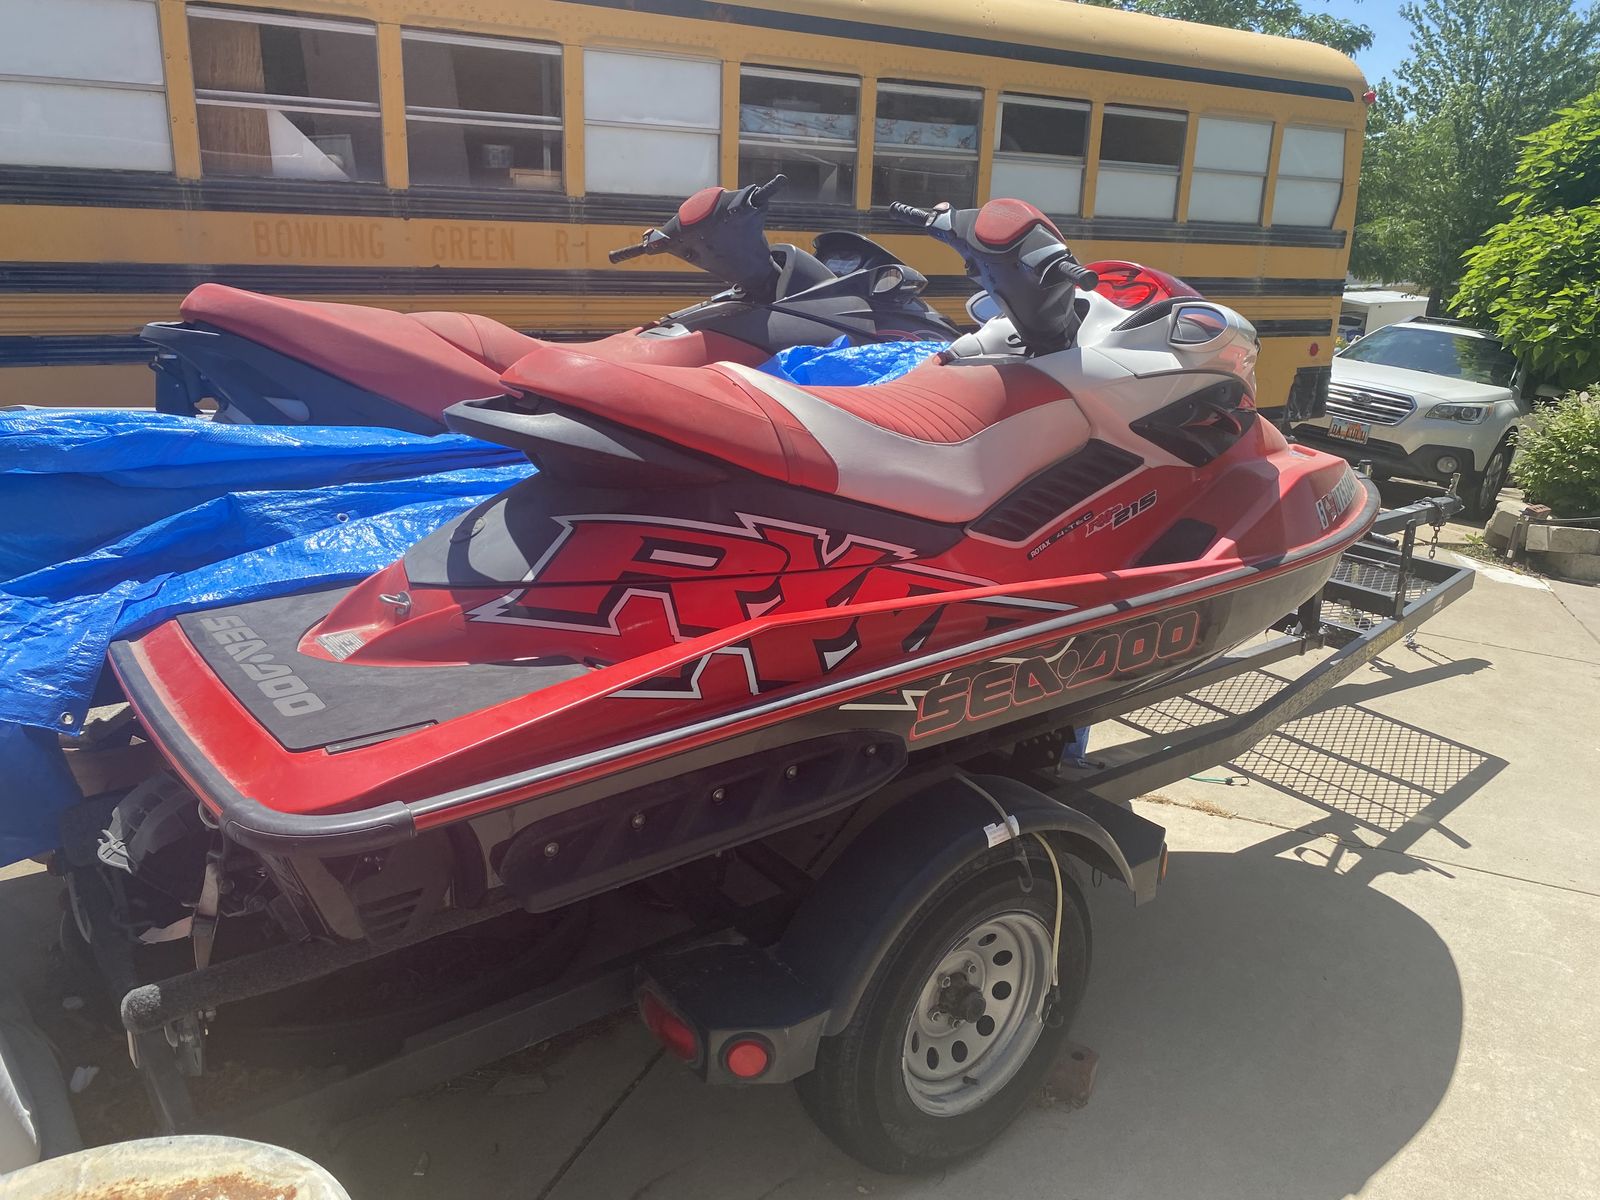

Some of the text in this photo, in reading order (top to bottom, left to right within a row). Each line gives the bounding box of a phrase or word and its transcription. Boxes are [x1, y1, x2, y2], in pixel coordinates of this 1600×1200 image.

[253, 220, 385, 260] BOWLING
[430, 225, 516, 262] GREEN
[1112, 490, 1157, 531] 215
[1030, 538, 1051, 558] ROTAX
